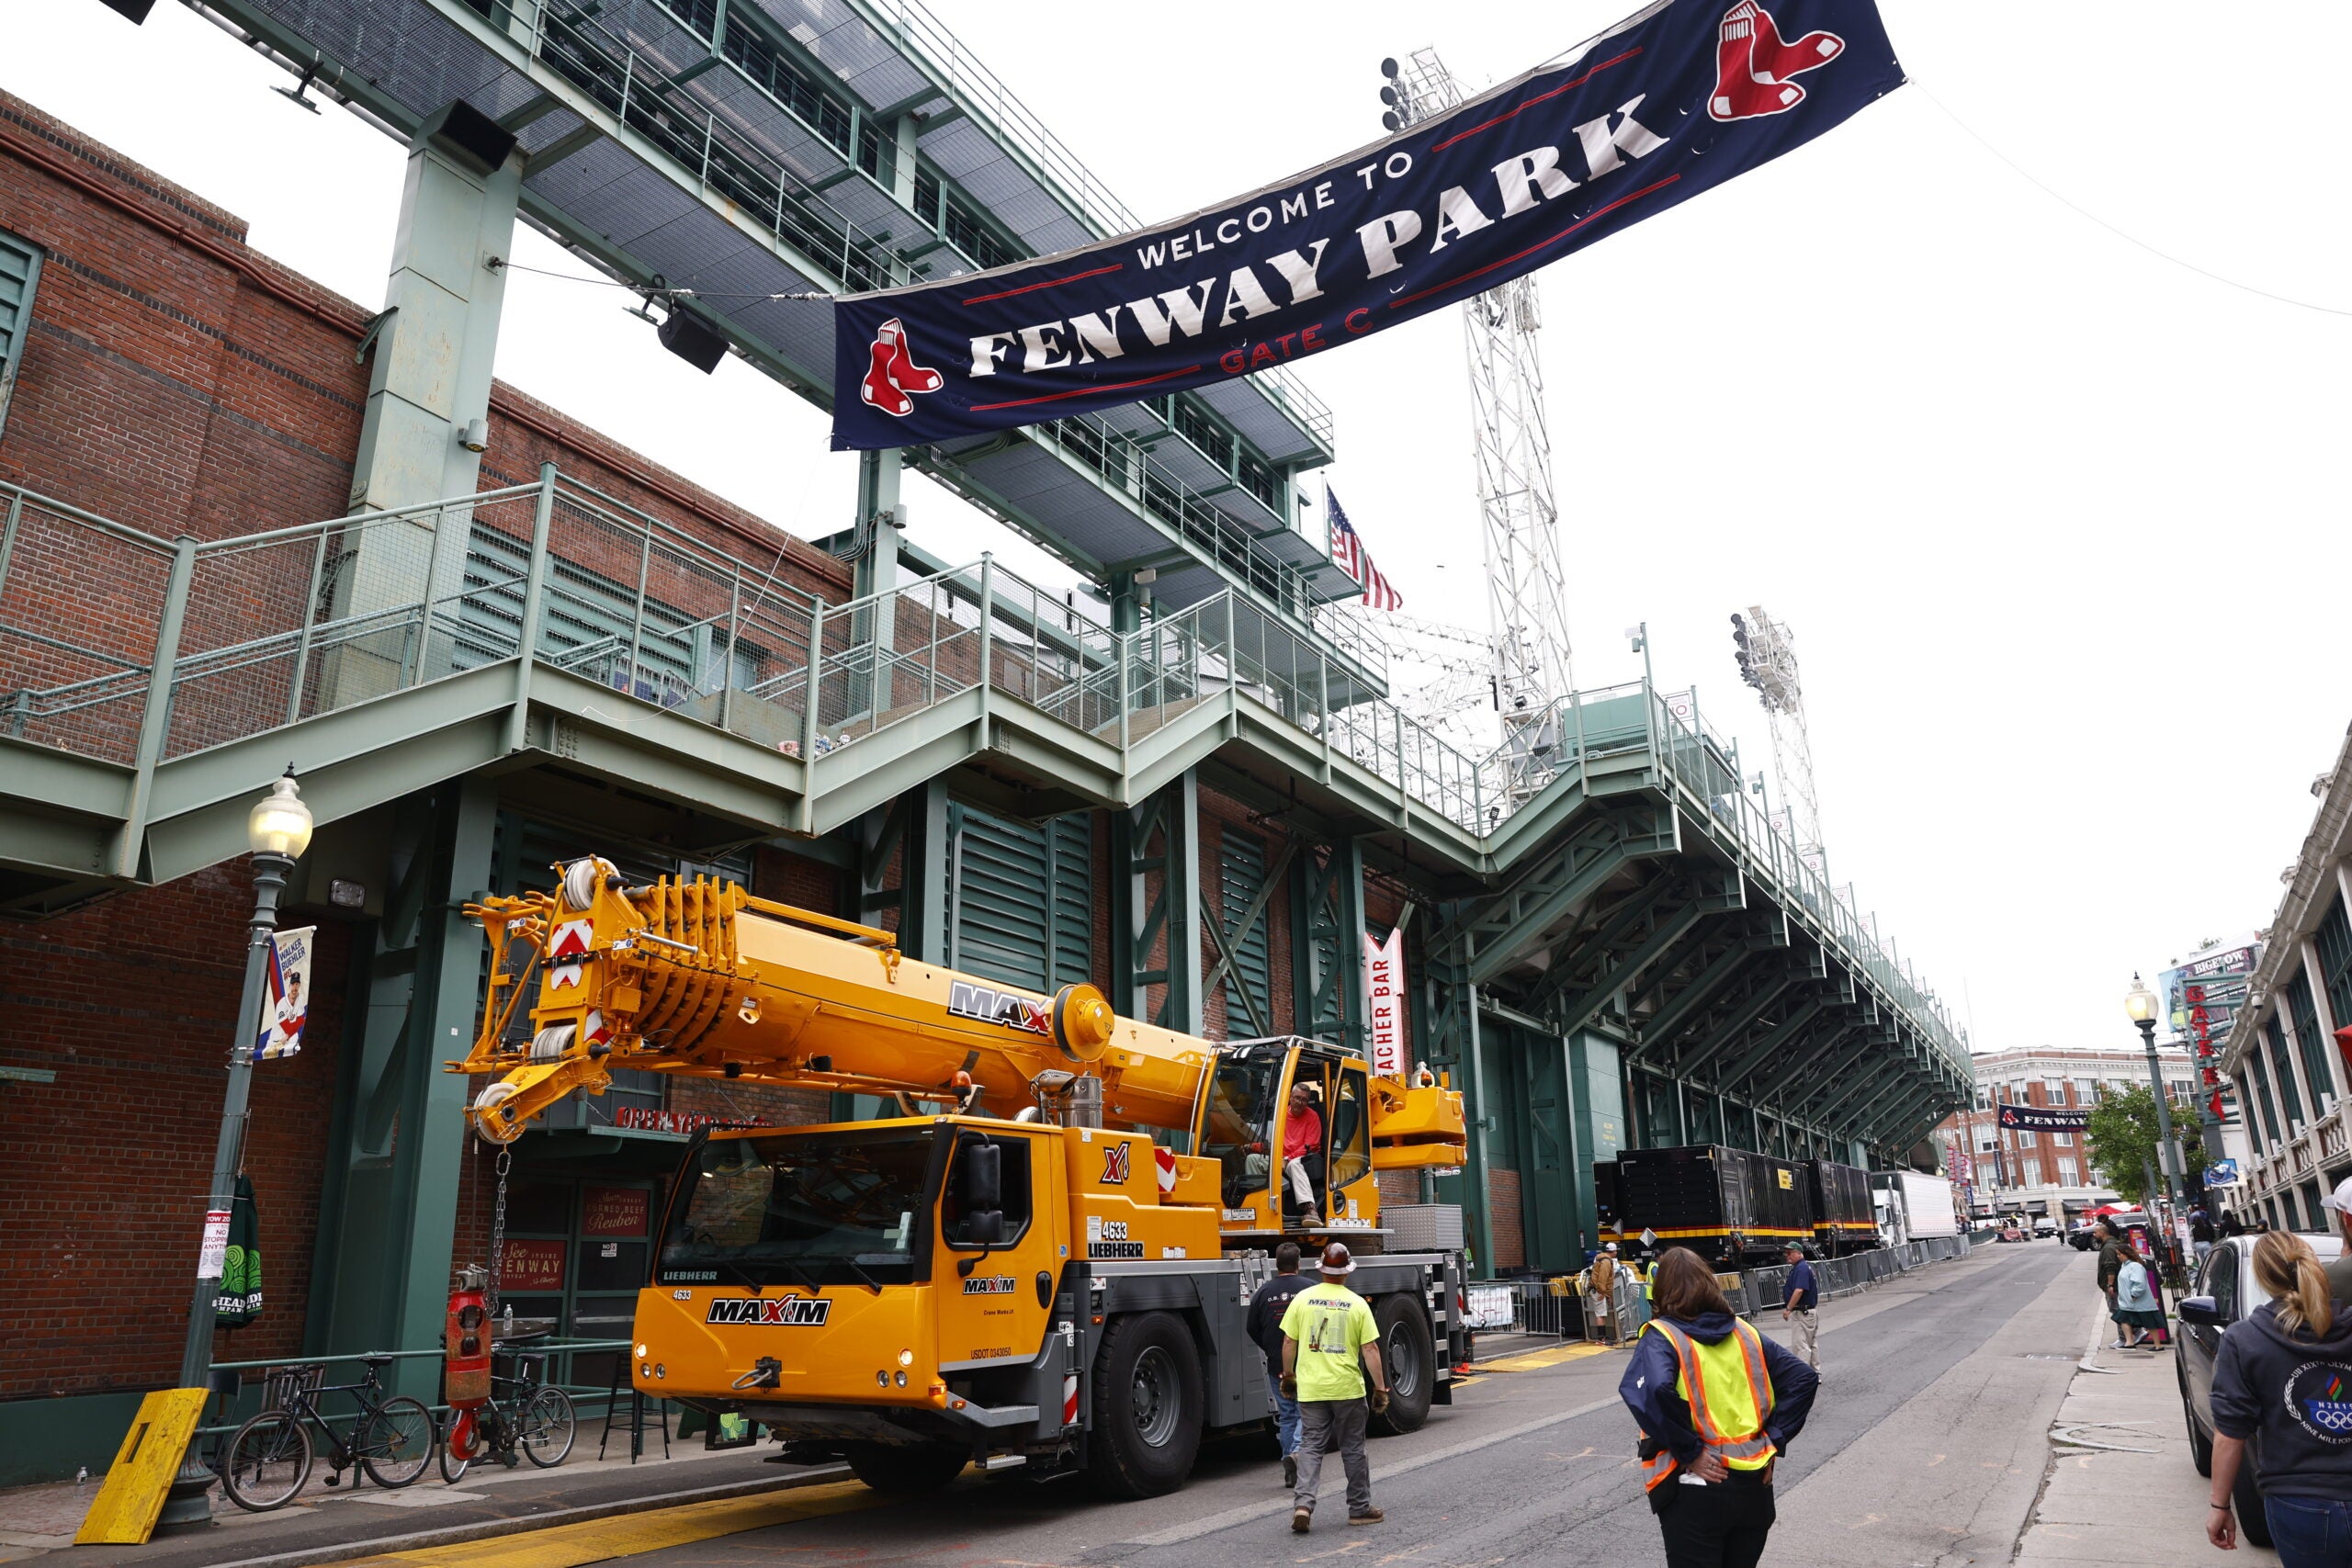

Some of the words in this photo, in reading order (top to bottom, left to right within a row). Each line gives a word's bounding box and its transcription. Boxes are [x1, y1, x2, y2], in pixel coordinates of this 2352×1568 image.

[1136, 181, 1335, 270] WELCOME
[1356, 152, 1413, 190] TO
[967, 238, 1329, 378] FENWAY
[1355, 93, 1670, 280] PARK
[1219, 323, 1326, 374] GATE
[1344, 308, 1374, 334] C
[278, 938, 302, 961] WALKER
[281, 946, 306, 971] BUEHLER
[1373, 960, 1390, 997] BAR
[947, 979, 1055, 1037] MAX
[1375, 1006, 1394, 1077] ACHER
[2185, 986, 2215, 1059] GATE
[2202, 1066, 2220, 1086] E
[616, 1106, 669, 1132] OPEN
[2024, 1115, 2086, 1125] FENWAY
[625, 1205, 645, 1213] BEEF
[588, 1211, 640, 1231] Reuben
[1102, 1222, 1127, 1240] 4633
[503, 1243, 528, 1259] See
[1088, 1243, 1144, 1258] LIEBHERR
[505, 1259, 560, 1273] ENWAY
[663, 1271, 718, 1280] LIEBHERR
[673, 1290, 692, 1301] 4633
[963, 1274, 1016, 1295] MAXIM
[706, 1293, 832, 1326] MAXIM
[1307, 1298, 1352, 1309] MAXIM
[970, 1348, 989, 1359] USDOT
[2301, 1420, 2319, 1437] NINE
[2318, 1433, 2337, 1445] MILE
